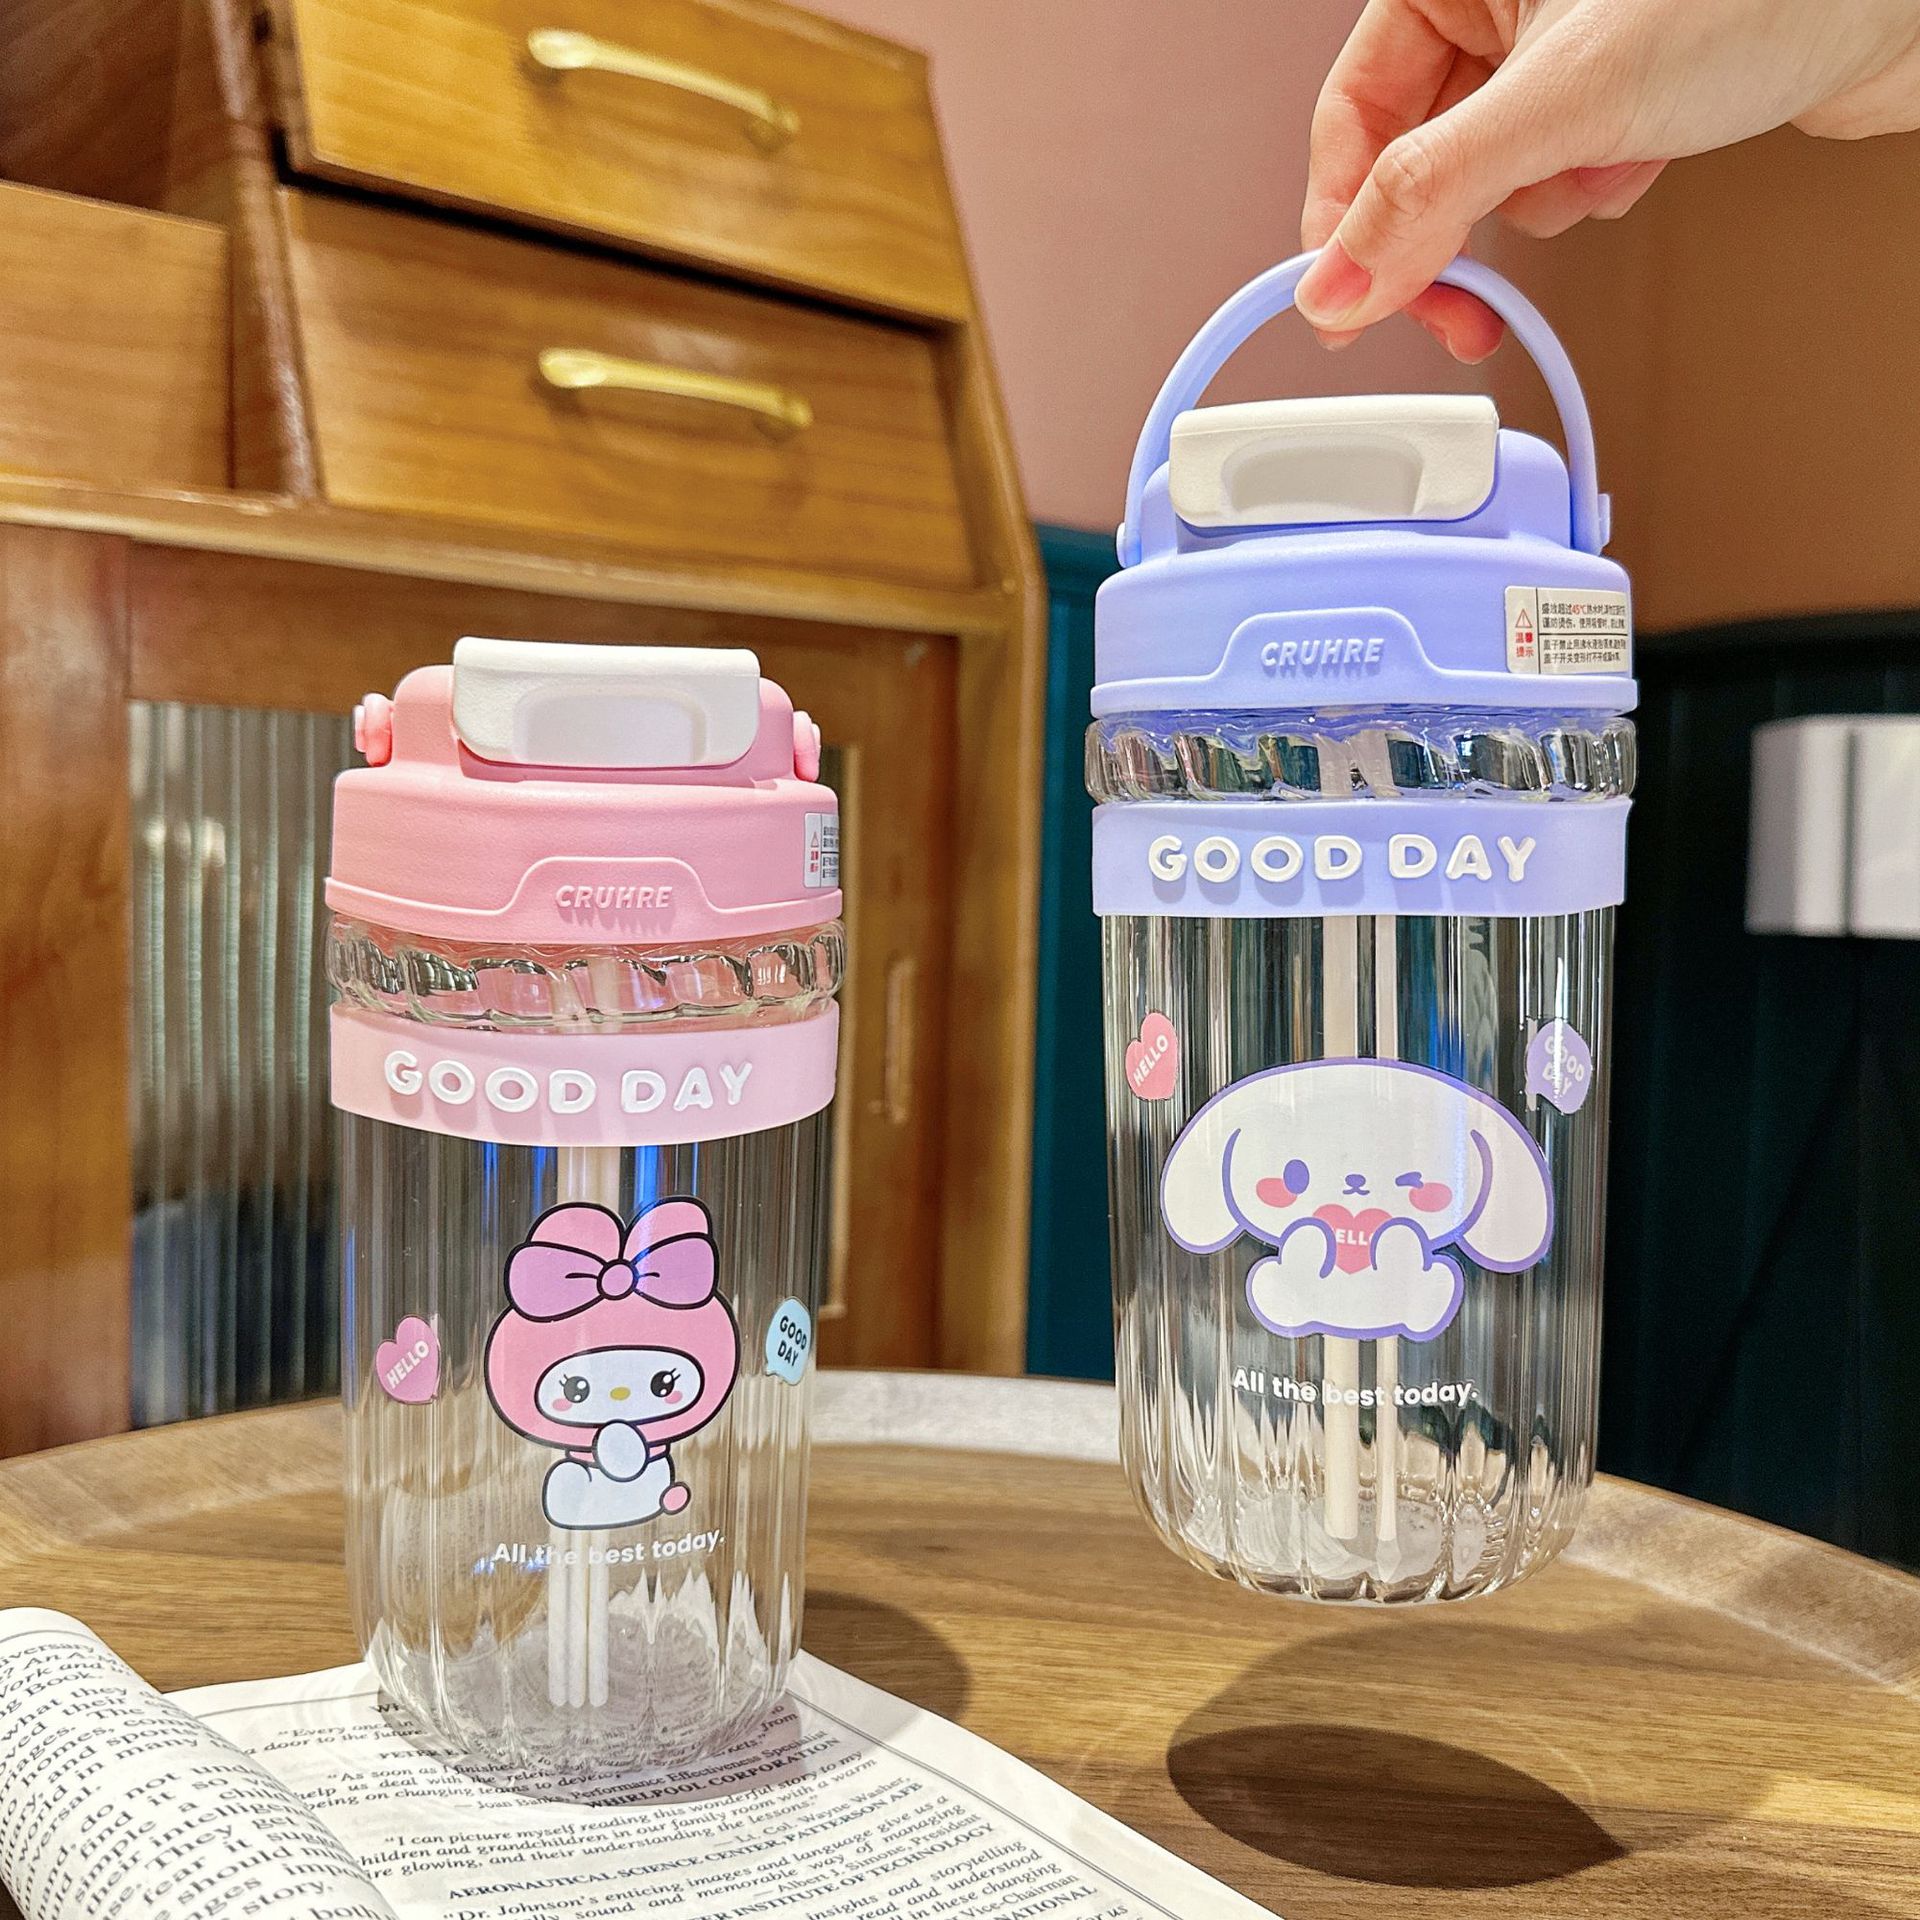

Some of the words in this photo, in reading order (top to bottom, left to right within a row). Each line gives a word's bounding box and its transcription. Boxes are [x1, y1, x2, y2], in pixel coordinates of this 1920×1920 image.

[1260, 638, 1385, 667] CRUHRE
[1147, 834, 1364, 883] GOOD
[1388, 833, 1538, 883] DAY
[555, 884, 673, 909] CRUHRE
[384, 1050, 598, 1115] GOOD
[620, 1061, 754, 1114] DAY
[1132, 1034, 1169, 1087] HELLO
[777, 1339, 800, 1367] DAY
[778, 1315, 808, 1351] GOOD
[385, 1339, 430, 1389] HELLO
[1233, 1367, 1265, 1393] All
[1271, 1375, 1317, 1402] the
[1321, 1379, 1385, 1407] best
[1393, 1380, 1479, 1408] today.
[494, 1542, 528, 1563] All
[535, 1544, 578, 1566] the
[588, 1543, 645, 1565] best
[651, 1529, 726, 1558] today.
[2, 1699, 62, 1741] what
[71, 1687, 127, 1698] they
[62, 1697, 126, 1716] their
[86, 1708, 145, 1719] The
[48, 1745, 97, 1784] and
[75, 1762, 103, 1780] in
[115, 1739, 199, 1760] many
[263, 1739, 310, 1751] door
[317, 1736, 335, 1744] to
[342, 1733, 369, 1742] the
[348, 1783, 369, 1791] us
[380, 1777, 418, 1787] deal
[471, 1775, 495, 1784] the
[365, 1792, 389, 1800] on
[535, 1781, 552, 1790] to
[371, 1768, 413, 1778] soon
[570, 1777, 666, 1799] Performance
[666, 1755, 762, 1782] Effectiveness
[584, 1781, 708, 1808] WHIRLPOOL
[708, 1736, 841, 1786] CORPORATION
[80, 1811, 133, 1860] find
[147, 1792, 176, 1806] it
[192, 1778, 229, 1790] so
[81, 1804, 114, 1833] do
[126, 1773, 180, 1799] not
[357, 1849, 431, 1866] hildren
[436, 1844, 471, 1856] and
[477, 1833, 609, 1855] grandchildren
[611, 1829, 632, 1838] in
[636, 1822, 666, 1834] our
[670, 1811, 726, 1830] family
[731, 1799, 776, 1816] room
[777, 1784, 815, 1803] with
[817, 1780, 829, 1789] a
[830, 1758, 878, 1782] warm
[411, 1835, 444, 1845] can
[449, 1831, 512, 1845] picture
[517, 1823, 575, 1839] myself
[580, 1814, 651, 1832] reading
[653, 1809, 686, 1819] this
[689, 1784, 775, 1812] wonderful
[778, 1770, 818, 1789] story
[819, 1761, 837, 1774] to
[838, 1751, 863, 1766] my
[75, 1820, 156, 1903] simple
[179, 1802, 198, 1812] a
[143, 1856, 206, 1905] fear
[222, 1839, 252, 1853] it
[145, 1825, 231, 1868] They
[401, 1858, 483, 1876] glowing,
[489, 1852, 525, 1864] and
[530, 1849, 575, 1861] their
[583, 1827, 715, 1855] understanding
[717, 1820, 745, 1832] the
[450, 1872, 617, 1899] AERONAUTICAL
[617, 1856, 704, 1878] SCIENCE
[784, 1798, 889, 1842] PATTERSON
[575, 1902, 636, 1919] sound
[648, 1893, 686, 1908] and
[697, 1868, 798, 1898] memorable
[808, 1854, 845, 1870] way
[856, 1841, 874, 1854] of
[882, 1804, 966, 1843] managing
[605, 1883, 684, 1902] enticing
[686, 1866, 752, 1887] images
[757, 1857, 790, 1871] and
[793, 1829, 873, 1861] language
[877, 1812, 911, 1833] give
[915, 1802, 934, 1815] us
[936, 1795, 949, 1805] a
[732, 1883, 840, 1917] INSTITUTE
[839, 1873, 866, 1887] OF
[865, 1822, 994, 1877] TECHNOLOGY
[777, 1873, 830, 1892] Albert
[910, 1813, 982, 1845] President
[888, 1877, 922, 1896] and
[930, 1841, 1027, 1881] storytelling
[178, 1846, 292, 1904] should
[242, 1881, 334, 1915] story.
[857, 1902, 899, 1920] read
[907, 1886, 942, 1905] and
[947, 1848, 1043, 1890] understood
[908, 1909, 930, 1920] in
[932, 1891, 978, 1912] these
[981, 1862, 1062, 1895] changing
[1106, 1904, 1128, 1917] us
